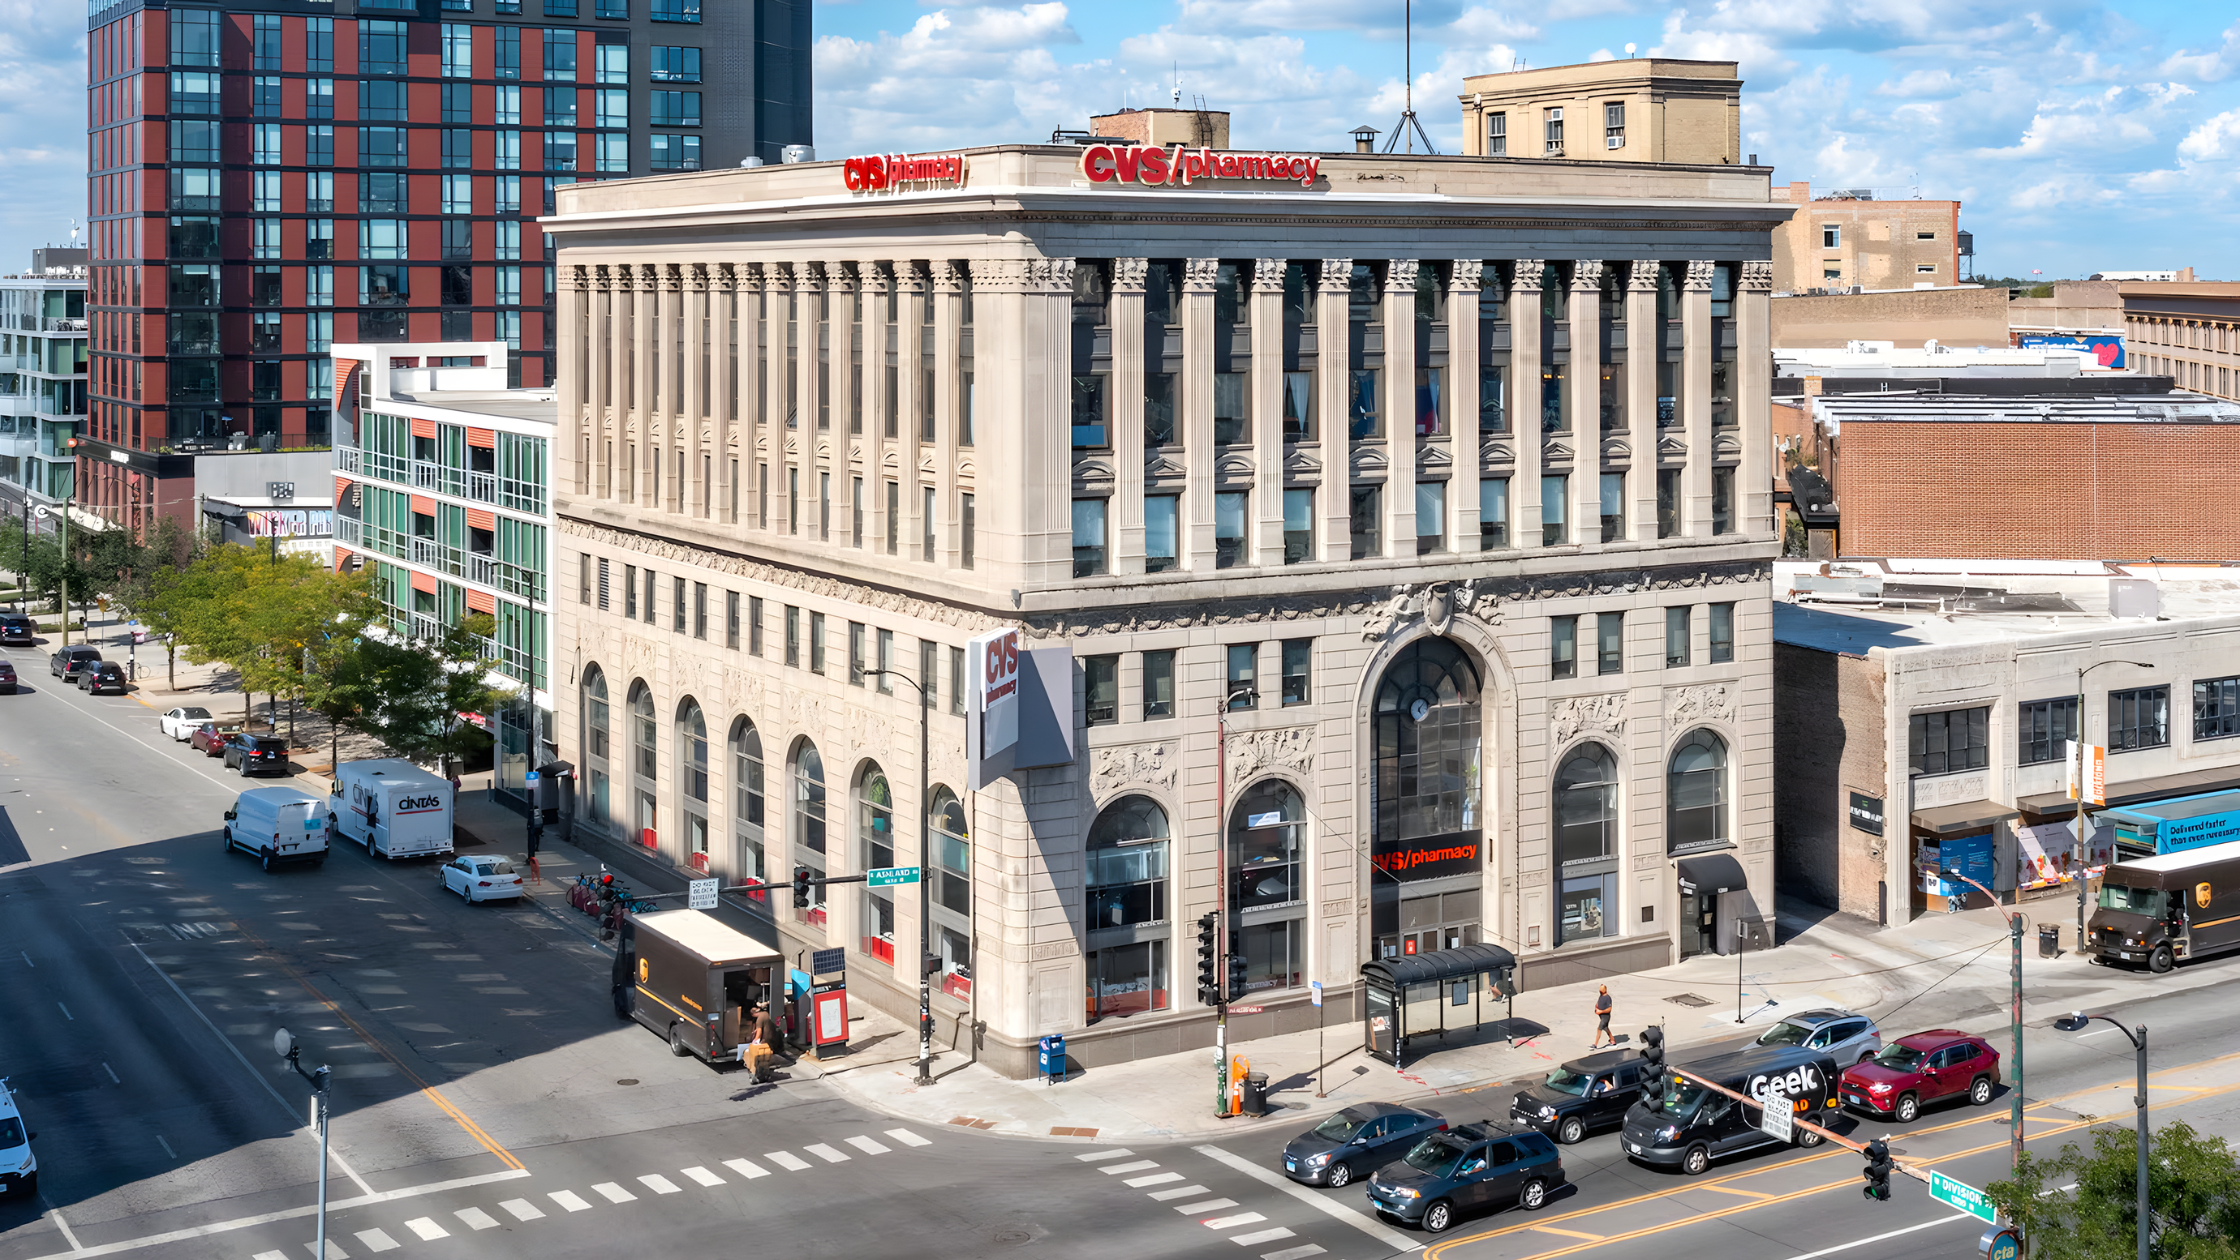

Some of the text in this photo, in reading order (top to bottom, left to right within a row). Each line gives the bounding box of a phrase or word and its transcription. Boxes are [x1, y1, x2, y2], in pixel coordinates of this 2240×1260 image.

[1082, 145, 1321, 187] CVS/pharmacy
[985, 632, 1018, 684] CVS
[1750, 1064, 1818, 1103] Geek
[1942, 1178, 1982, 1206] DIVISION
[1994, 1245, 2015, 1260] cta
